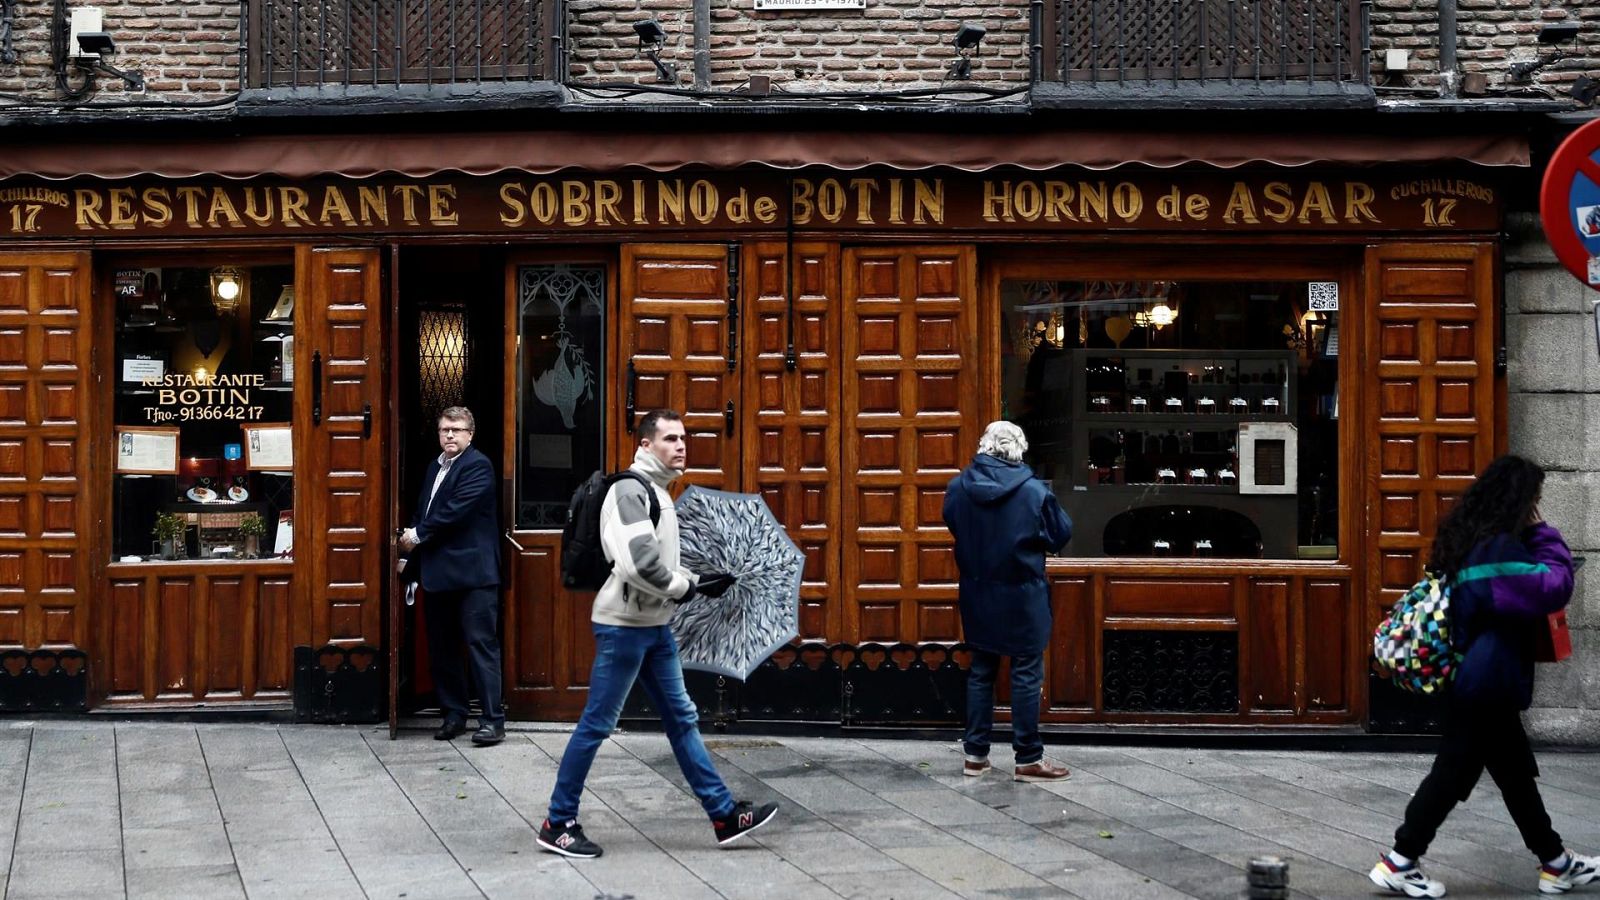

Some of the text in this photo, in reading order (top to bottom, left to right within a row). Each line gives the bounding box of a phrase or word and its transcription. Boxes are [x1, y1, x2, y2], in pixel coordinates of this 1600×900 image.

[74, 184, 459, 230] RESTAURANTE
[499, 178, 945, 228] SOBRINO de BOTIN
[982, 181, 1383, 224] HORNO de ASAR
[1390, 178, 1494, 205] CUCHILLEROS
[121, 285, 137, 295] AR
[159, 389, 249, 405] BOTIN
